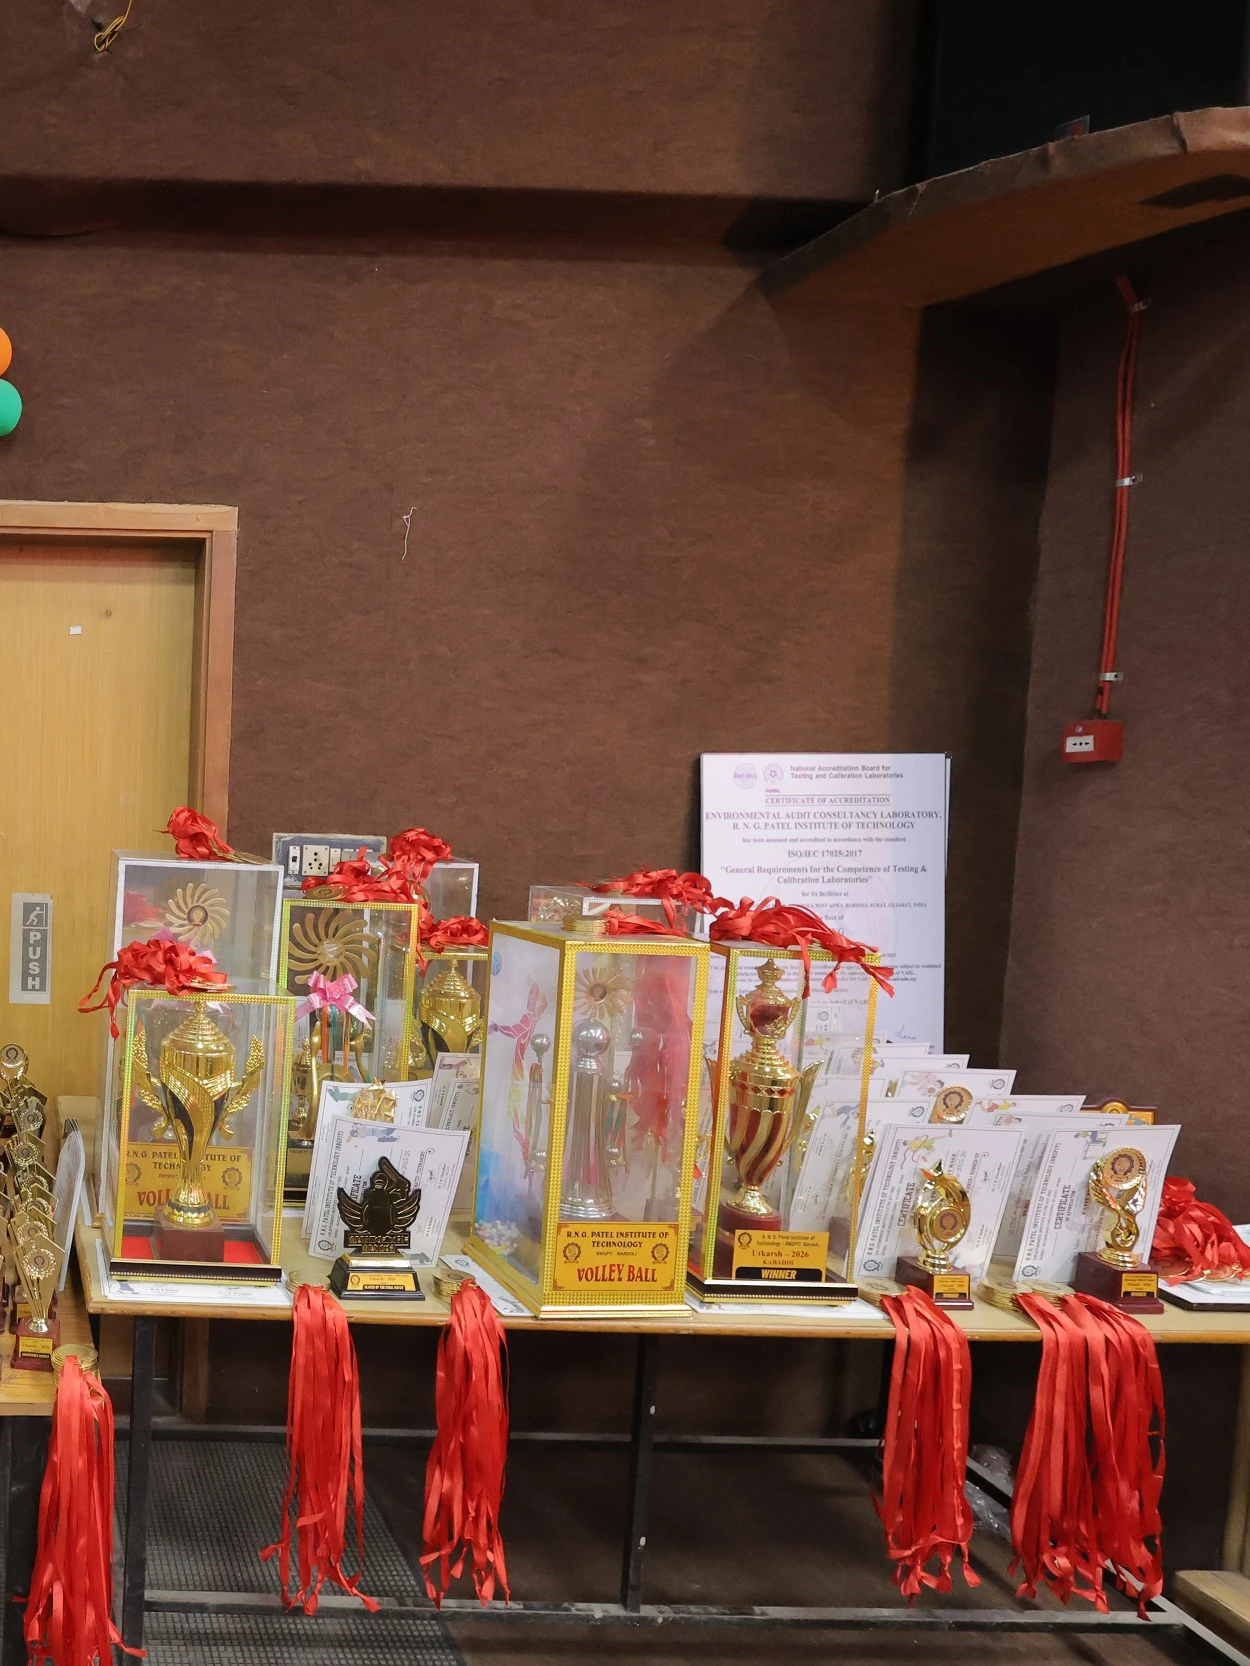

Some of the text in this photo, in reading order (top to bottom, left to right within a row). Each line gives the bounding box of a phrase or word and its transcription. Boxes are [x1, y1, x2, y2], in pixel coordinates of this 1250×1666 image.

[791, 772, 813, 780] Testing
[815, 772, 826, 780] and
[865, 772, 904, 780] Laboratories
[705, 811, 942, 820] ENVIRONMENTAL AUDIT CONSULTANCY LABORATORY,
[733, 822, 916, 830] R. N. G. PATEL INSTITUTE OF TECHNOLOGY
[788, 850, 863, 858] ISO/IEC 17025:2017
[757, 866, 808, 874] Requirements
[810, 866, 821, 874] for
[823, 866, 835, 874] the
[836, 866, 881, 874] Competence
[883, 866, 891, 874] of
[893, 866, 919, 874] Testing
[920, 866, 927, 874] &
[777, 876, 820, 884] Calibration
[27, 931, 42, 990] PUSH
[153, 1162, 211, 1171] TECHNGY
[898, 1182, 915, 1227] CERTIFICATE
[1054, 1184, 1071, 1230] CERTIFICATE
[577, 1264, 657, 1282] VOLLEY BALL
[761, 1269, 797, 1280] WINNER
